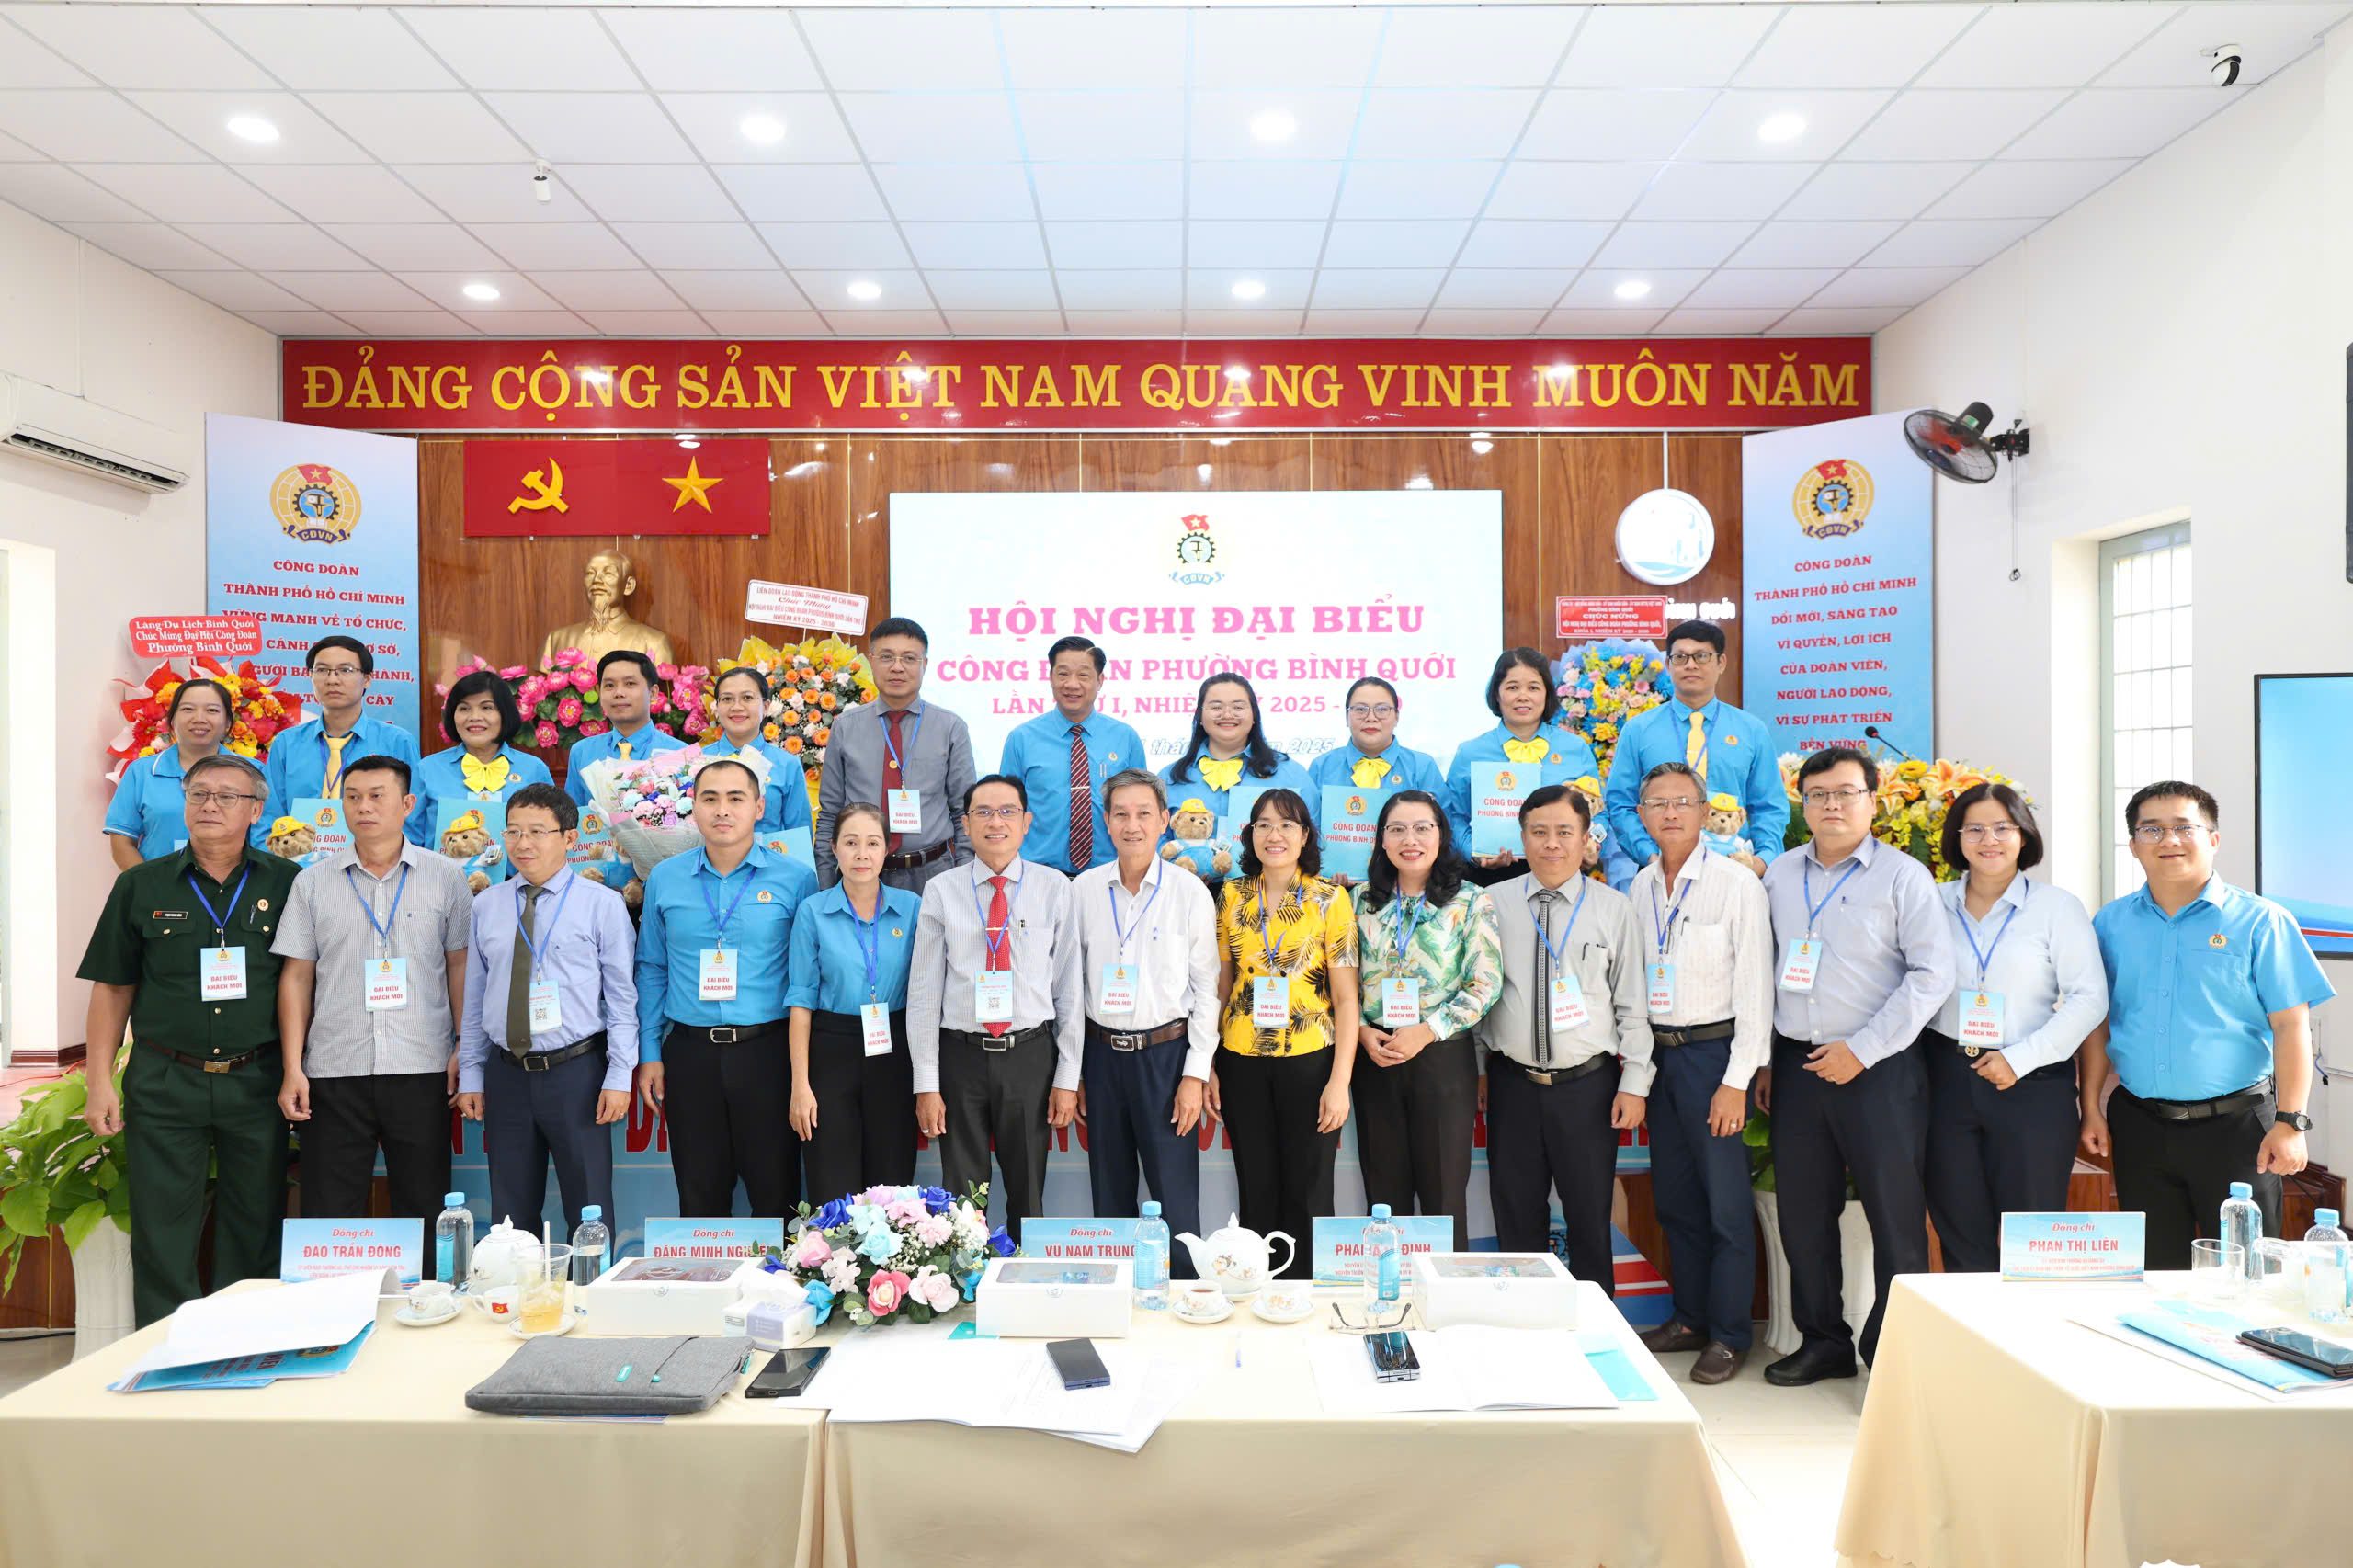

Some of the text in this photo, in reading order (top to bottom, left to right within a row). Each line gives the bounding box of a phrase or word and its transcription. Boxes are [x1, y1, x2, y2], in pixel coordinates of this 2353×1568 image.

[302, 344, 1859, 423] ĐẢNG CỘNG SẢN VIỆT NAM QUANG VINH MUÔN NĂM
[301, 530, 334, 542] CĐVN
[273, 559, 359, 576] CÔNG ĐOÀN
[1794, 555, 1872, 573] CÔNG ĐOÀN
[223, 582, 404, 605] THÀNH PHỐ HỒ CHÍ MINH
[1754, 577, 1916, 601] THÀNH PHỐ HỒ CHÍ MINH
[271, 610, 317, 626] MẠNH
[321, 612, 340, 626] VỀ
[344, 613, 363, 628] TỔ
[365, 617, 407, 631] CHỨC,
[969, 593, 1424, 642] HỘI NGHỊ ĐẠI BIỂU
[1796, 609, 1824, 623] MỚI,
[1827, 607, 1866, 620] SÁNG
[1868, 606, 1898, 619] TẠO
[164, 620, 179, 630] Du
[182, 619, 203, 631] Lịch
[231, 619, 255, 628] Quới
[136, 631, 157, 641] Chúc
[159, 630, 182, 642] Mừng
[216, 630, 235, 642] Công
[237, 630, 257, 640] Đoàn
[1843, 633, 1865, 646] LỢI
[147, 641, 253, 654] Phường Bình Quới
[266, 638, 309, 651] CÁNH
[378, 643, 400, 657] SỞ,
[251, 665, 287, 676] GƯỜI
[291, 666, 310, 677] BẠ
[937, 654, 1029, 682] CÔNG
[1142, 653, 1279, 682] PHƯỜNG
[1287, 653, 1368, 679] BÌNH
[1377, 651, 1456, 682] QUỚI
[1810, 660, 1847, 673] ĐOÀN
[1851, 658, 1888, 672] VIÊN,
[366, 692, 394, 707] CẬY
[1777, 685, 1892, 700] NGƯỜI LAO ĐỘNG,
[993, 690, 1045, 714] LẦN
[1111, 697, 1127, 718] I,
[1134, 691, 1196, 717] NHIỆ
[1270, 696, 1326, 712] 2025
[1792, 714, 1810, 726] SỰ
[1813, 711, 1847, 724] PHÁT
[1851, 708, 1893, 722] TRIỂN
[1288, 737, 1336, 756] 2025
[1799, 736, 1825, 751] BỀN
[1506, 798, 1525, 807] ĐOÀ
[368, 1243, 402, 1258] ĐÔNG
[690, 1245, 722, 1257] MINH
[1065, 1245, 1093, 1257] NAM
[2029, 1237, 2119, 1254] PHAN THỊ LIÊN
